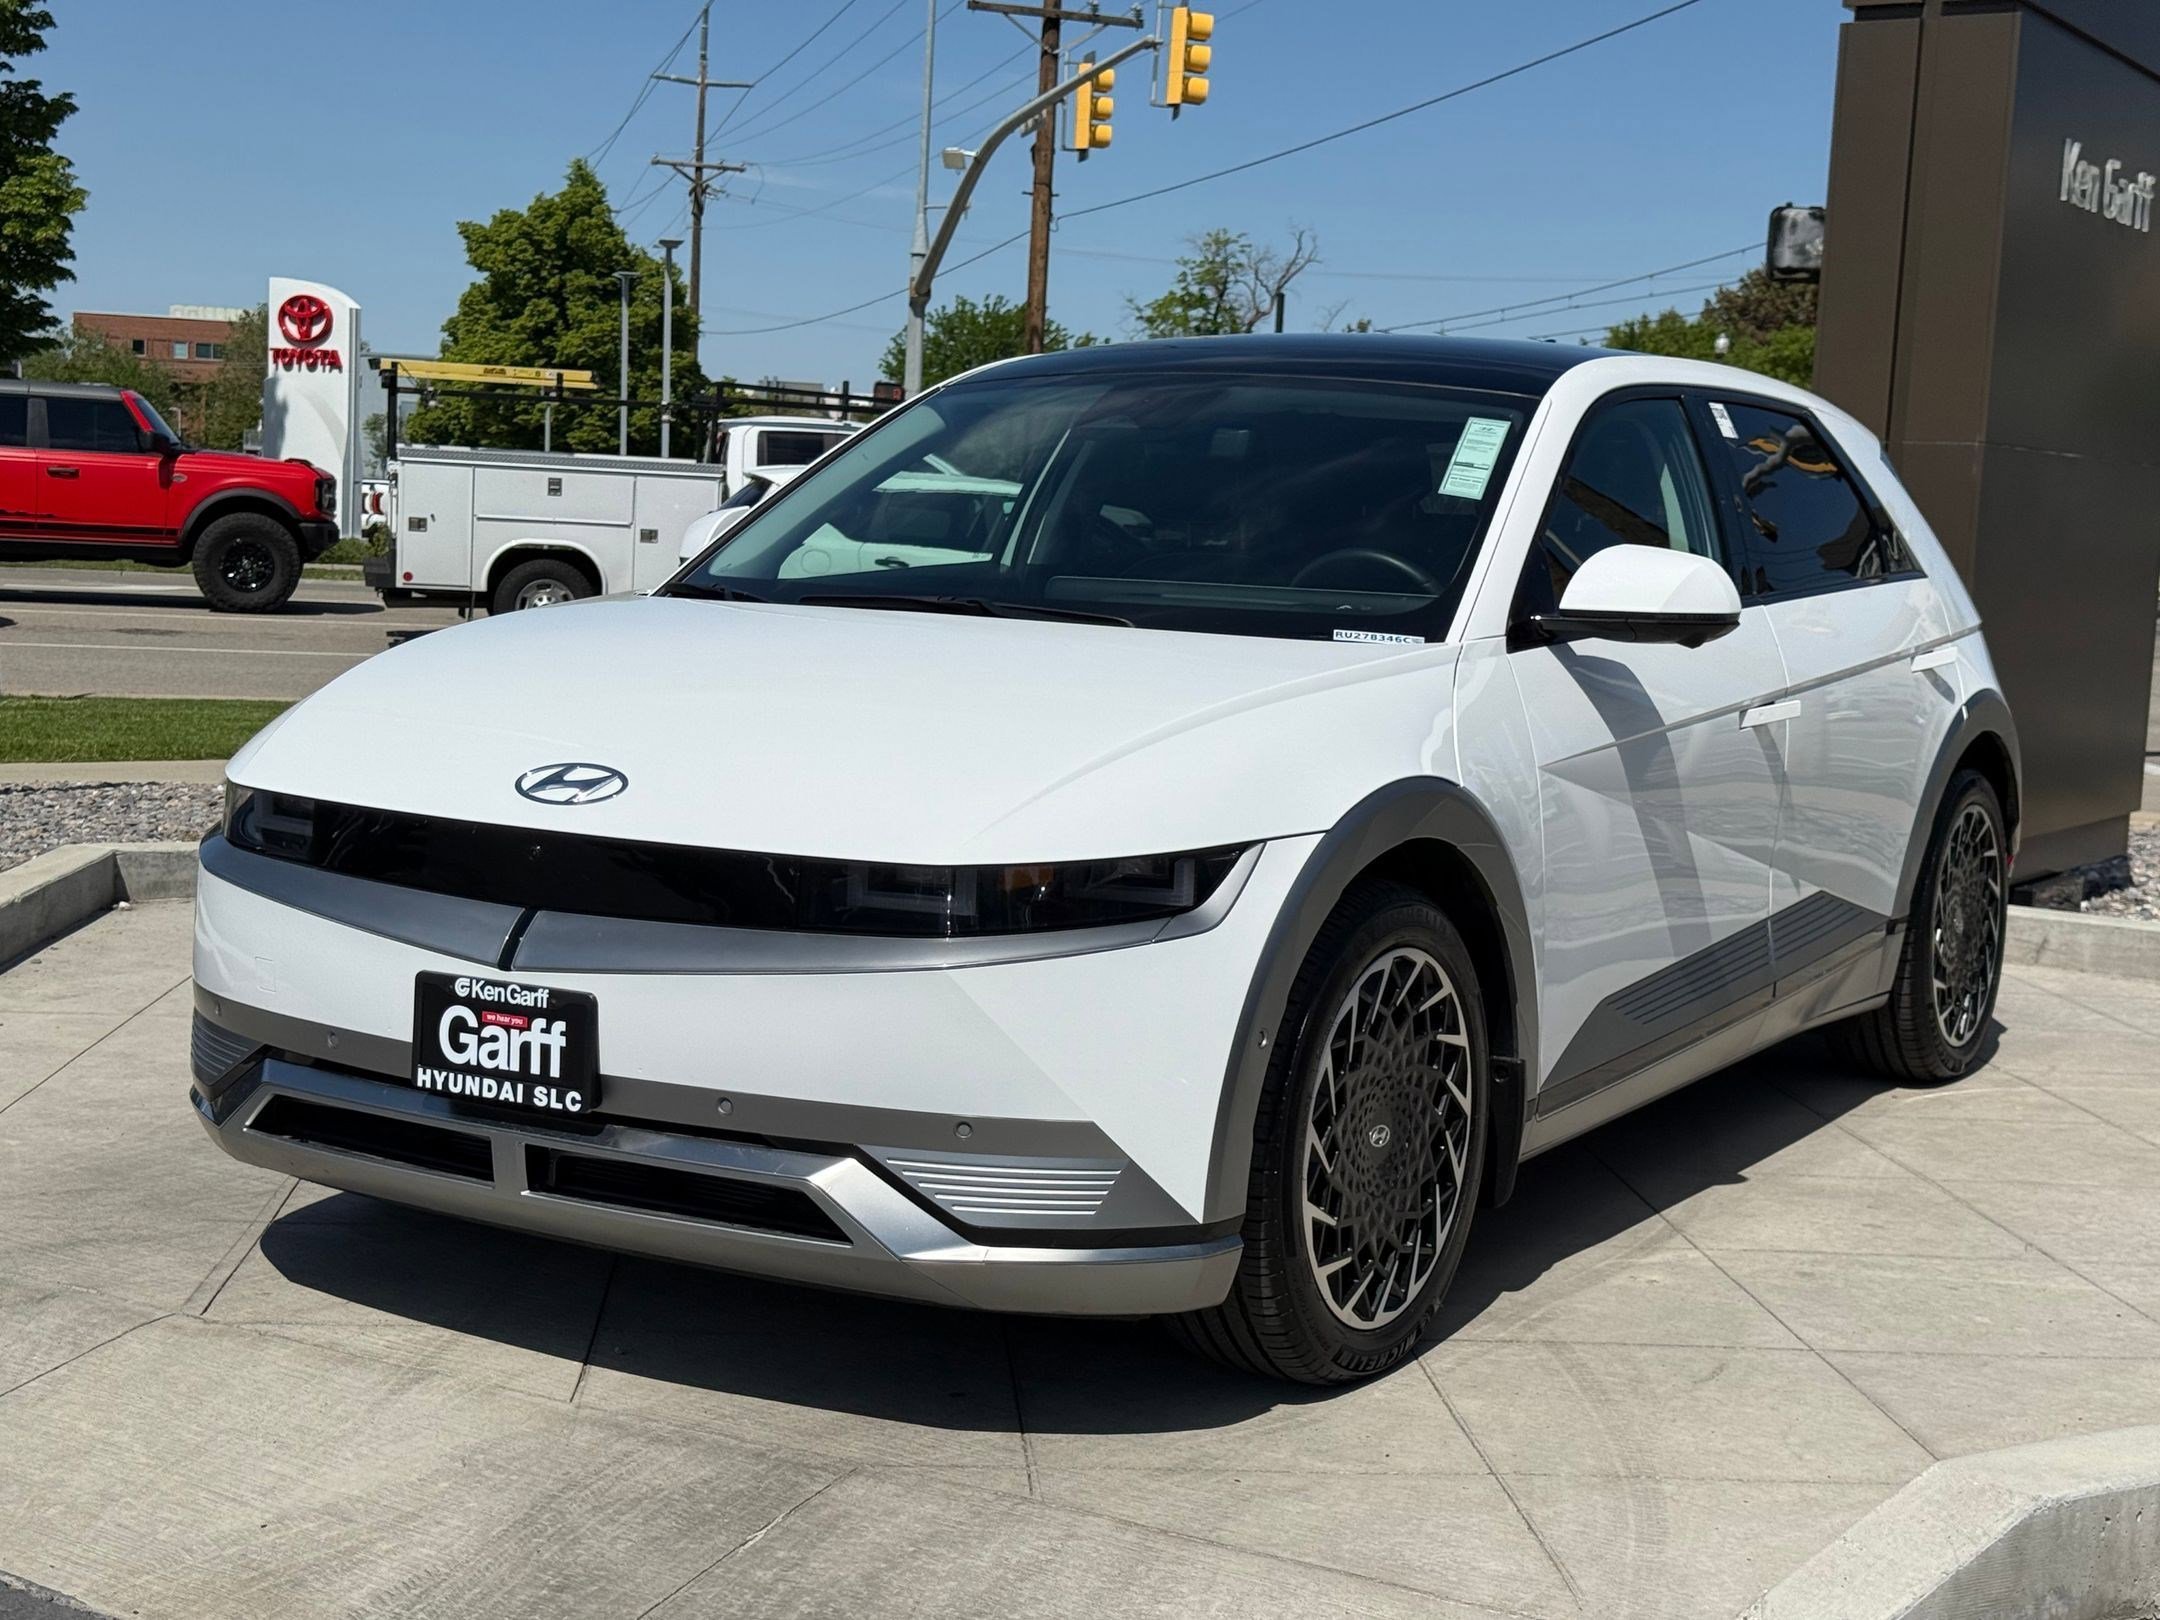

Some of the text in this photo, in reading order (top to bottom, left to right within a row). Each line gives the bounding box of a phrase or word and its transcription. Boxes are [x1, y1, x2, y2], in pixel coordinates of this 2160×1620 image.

[2060, 138, 2156, 232] Ken Garff
[269, 348, 343, 371] TOYOTA
[472, 979, 549, 1008] Ken Garff
[439, 1005, 567, 1078] Garff
[417, 1067, 582, 1112] HYUNDAI SLC
